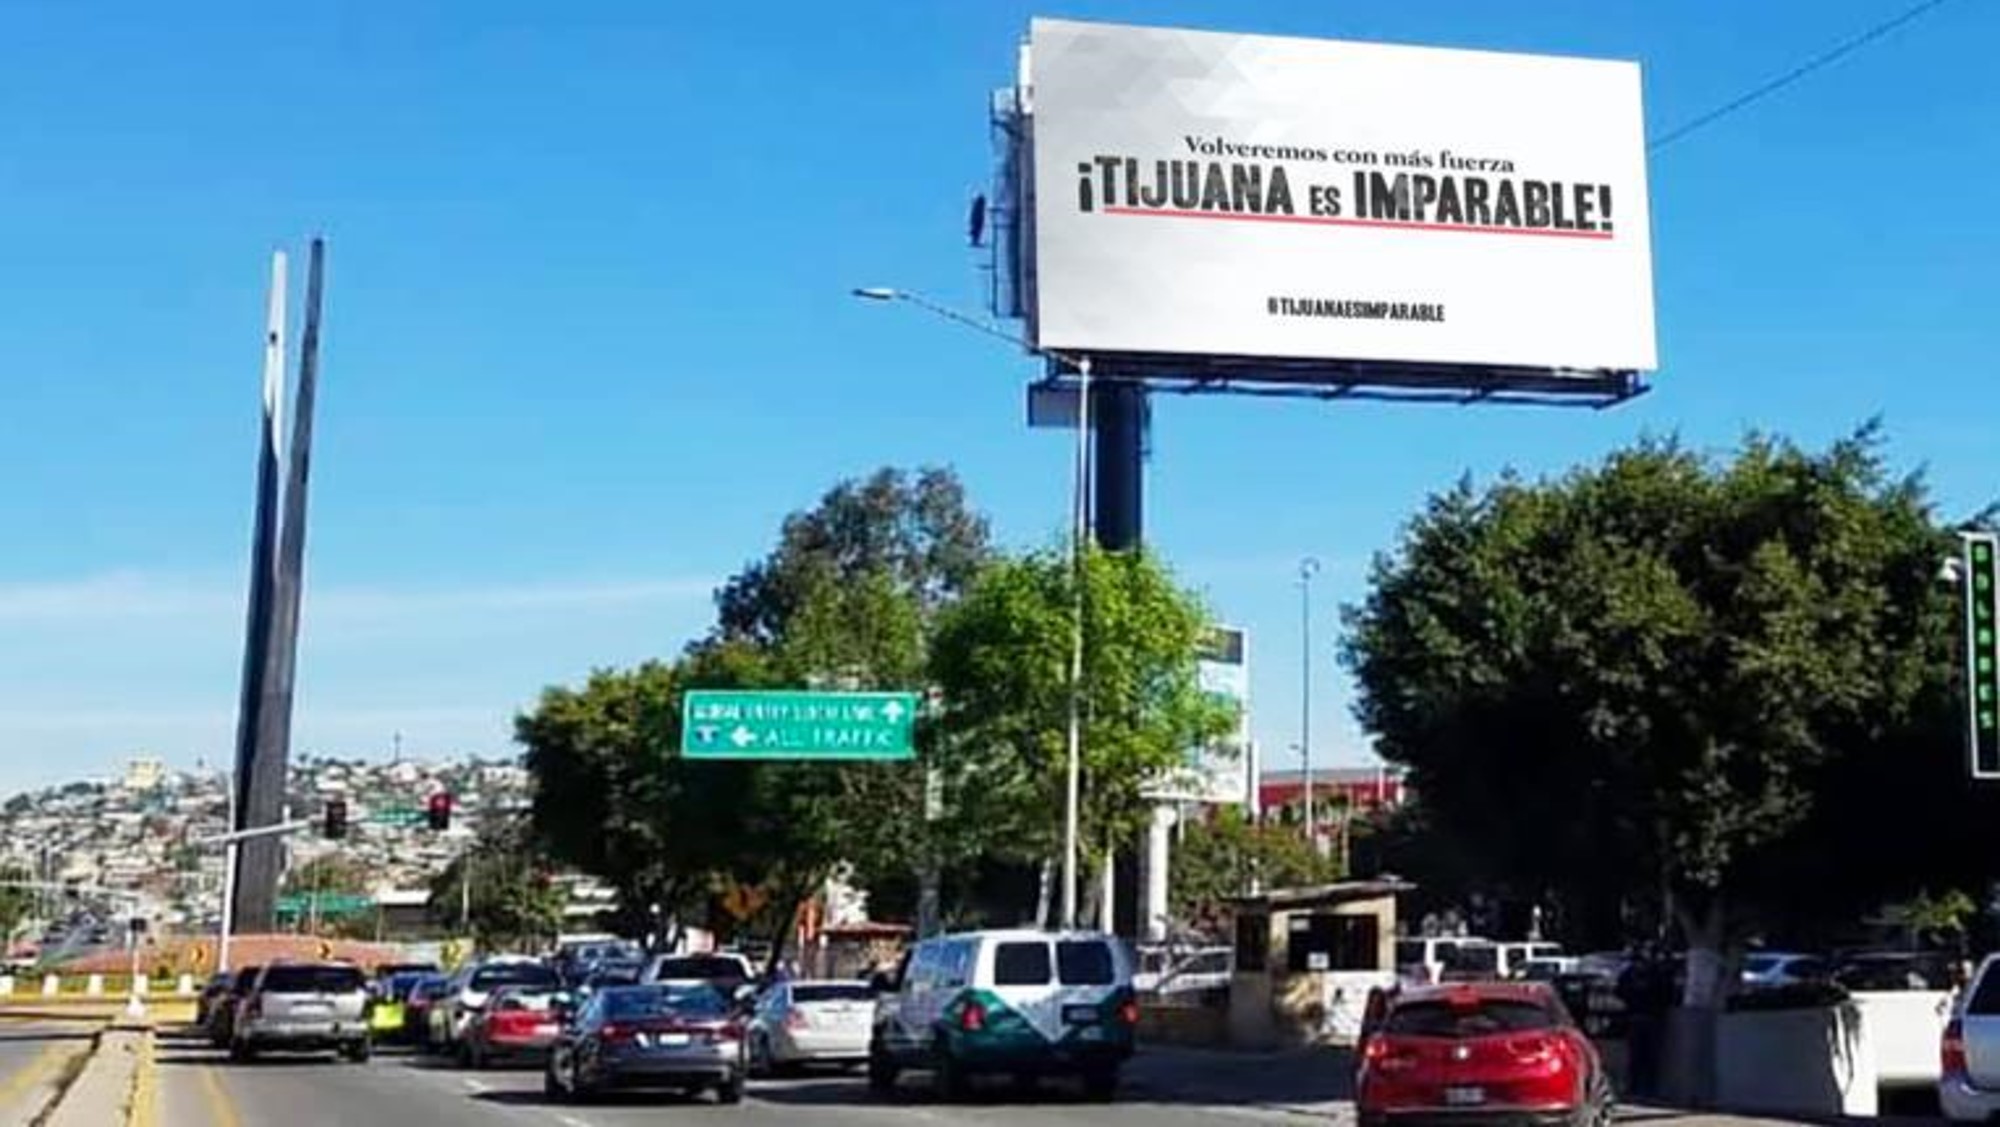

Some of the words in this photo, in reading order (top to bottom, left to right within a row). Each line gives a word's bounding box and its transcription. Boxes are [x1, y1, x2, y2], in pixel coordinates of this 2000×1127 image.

[1185, 136, 1327, 163] Volveremos
[1333, 151, 1377, 168] con
[1385, 150, 1434, 168] más
[1440, 151, 1514, 173] fuerza
[1079, 155, 1294, 215] ¡TIJUANA
[1309, 185, 1341, 216] ES
[1354, 170, 1613, 231] IMPARABLE!
